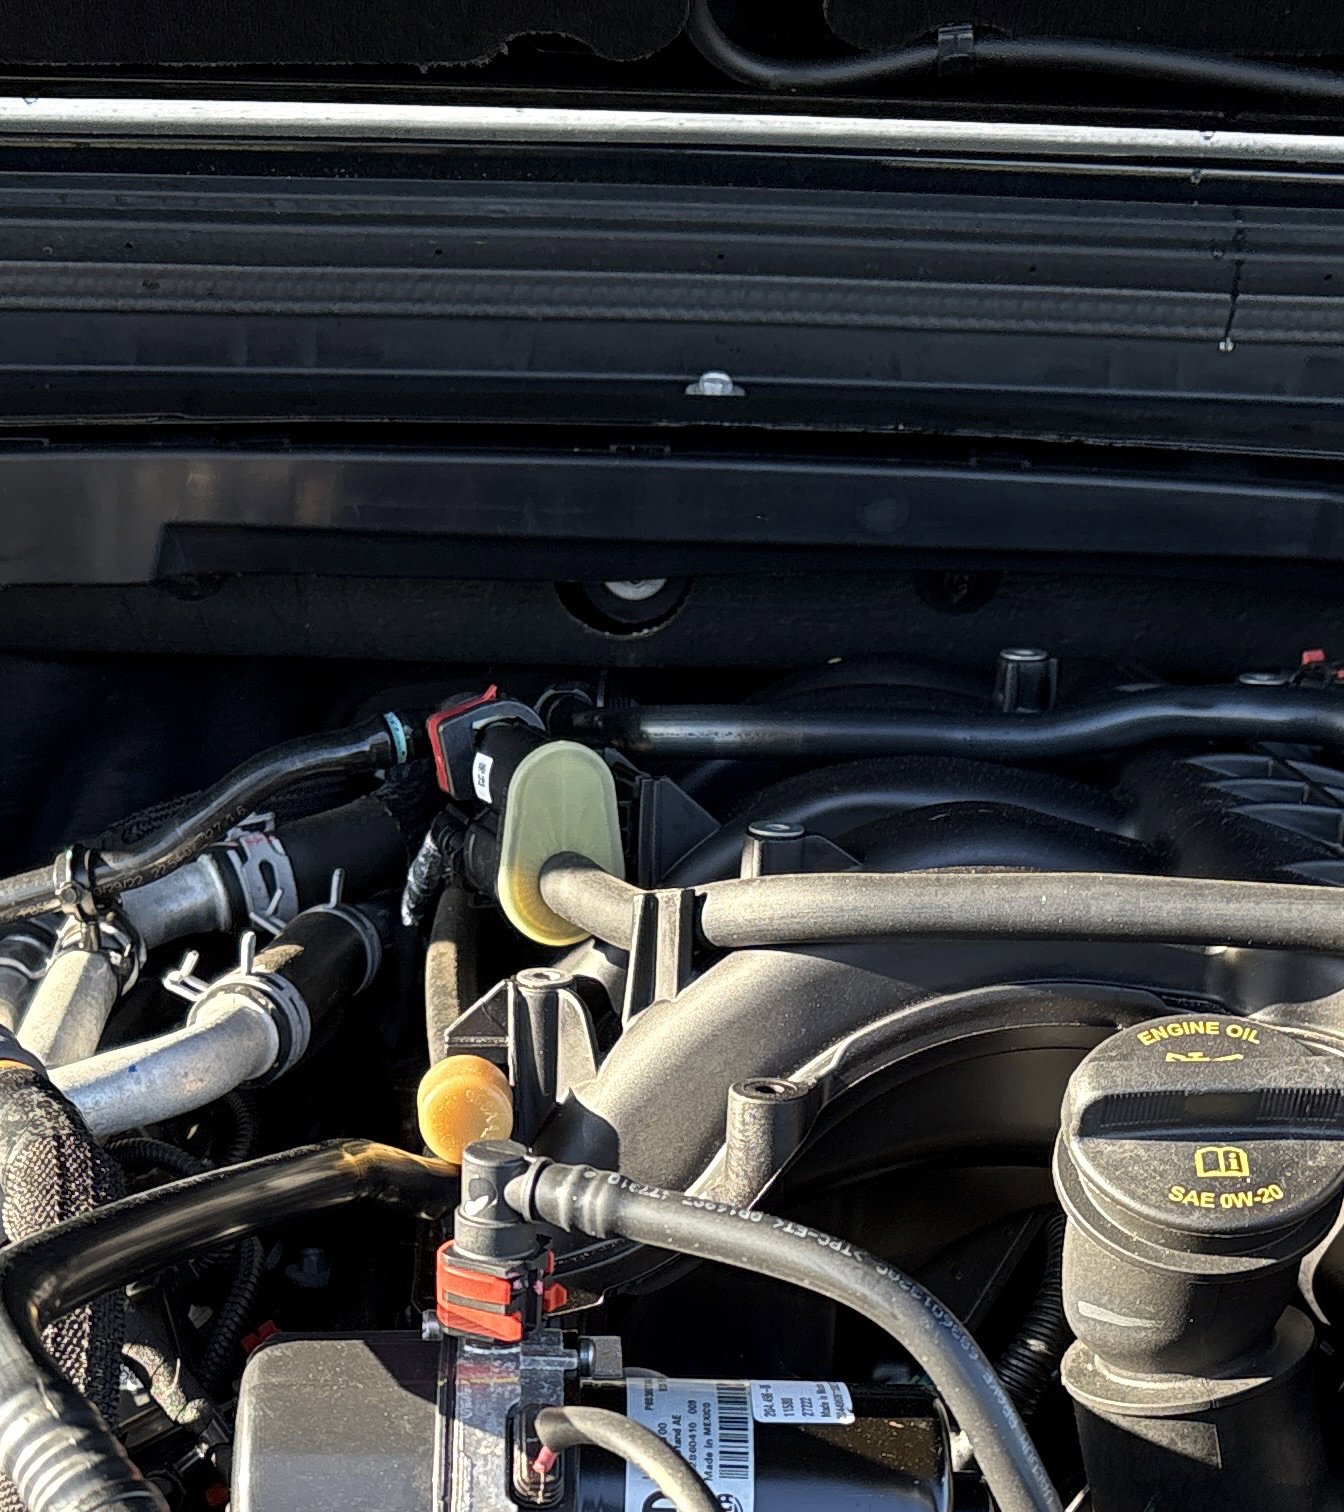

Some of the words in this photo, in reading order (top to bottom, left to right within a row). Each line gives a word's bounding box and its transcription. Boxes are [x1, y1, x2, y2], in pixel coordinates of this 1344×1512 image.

[1136, 1020, 1220, 1047] ENGINE
[1226, 1023, 1261, 1046] OIL
[1168, 1184, 1214, 1208] SAE
[1219, 1183, 1285, 1210] 0W-20
[982, 1372, 1019, 1433] BRAKE
[702, 1401, 713, 1436] MEXICO
[703, 1451, 714, 1482] Made
